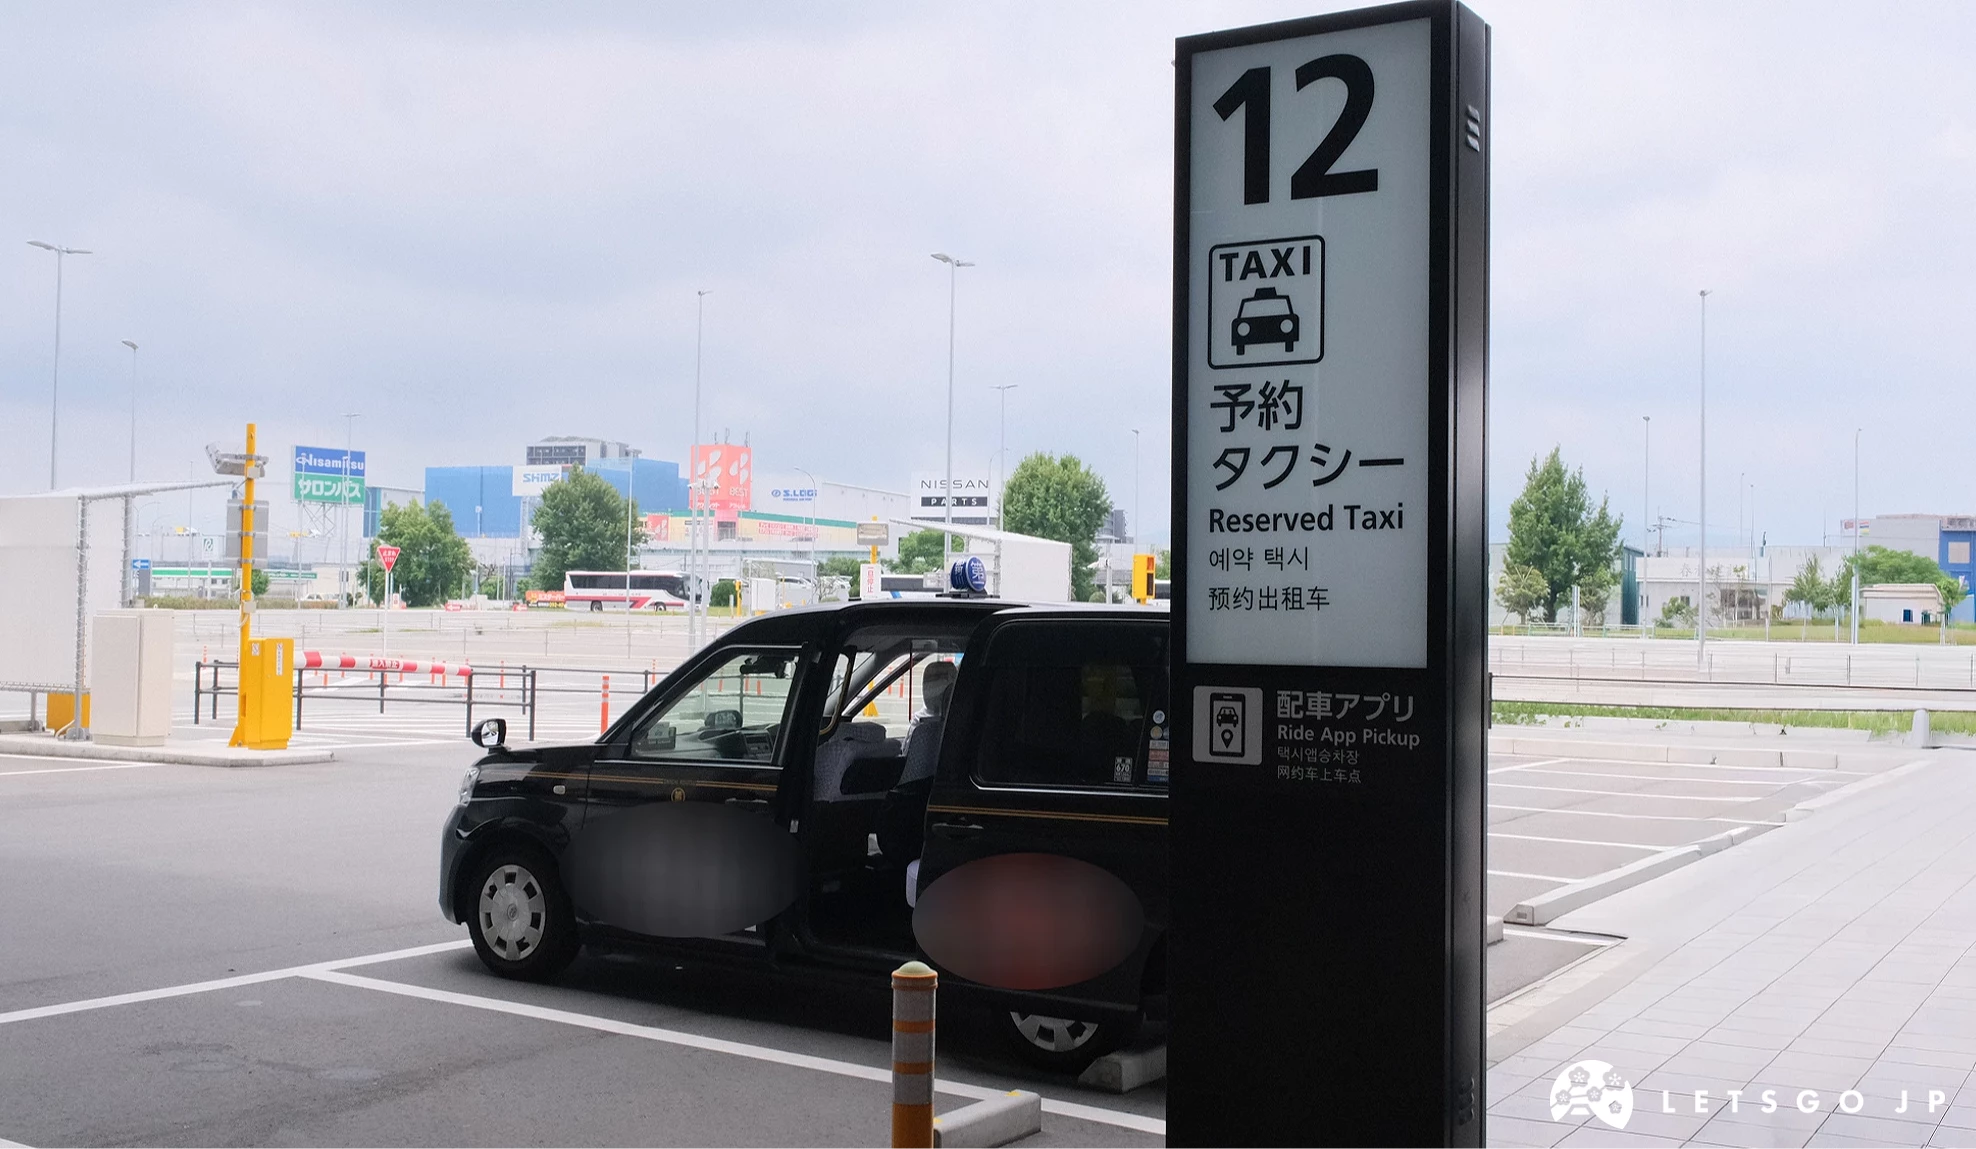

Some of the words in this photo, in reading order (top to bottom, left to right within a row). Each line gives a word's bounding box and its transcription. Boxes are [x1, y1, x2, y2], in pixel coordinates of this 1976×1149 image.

[1213, 53, 1378, 205] 12
[1219, 246, 1311, 282] TAXI
[1210, 380, 1303, 433] 予約
[1212, 442, 1404, 491] タクシー
[298, 480, 361, 498] サロンパス
[730, 487, 748, 498] BEST
[921, 480, 989, 489] NISSAN
[931, 498, 977, 506] PARTS
[1209, 504, 1334, 533] Reserved
[1343, 503, 1404, 531] Taxi
[1209, 547, 1254, 572] 예약
[1264, 546, 1310, 571] 택시
[971, 561, 984, 584] 第一
[1209, 586, 1330, 611] 预约出租车
[1276, 690, 1415, 722] 配車アプリ
[1277, 724, 1314, 741] Ride
[1321, 727, 1357, 745] App
[1362, 728, 1421, 749] Pickup
[1277, 765, 1361, 784] 网约车上车点
